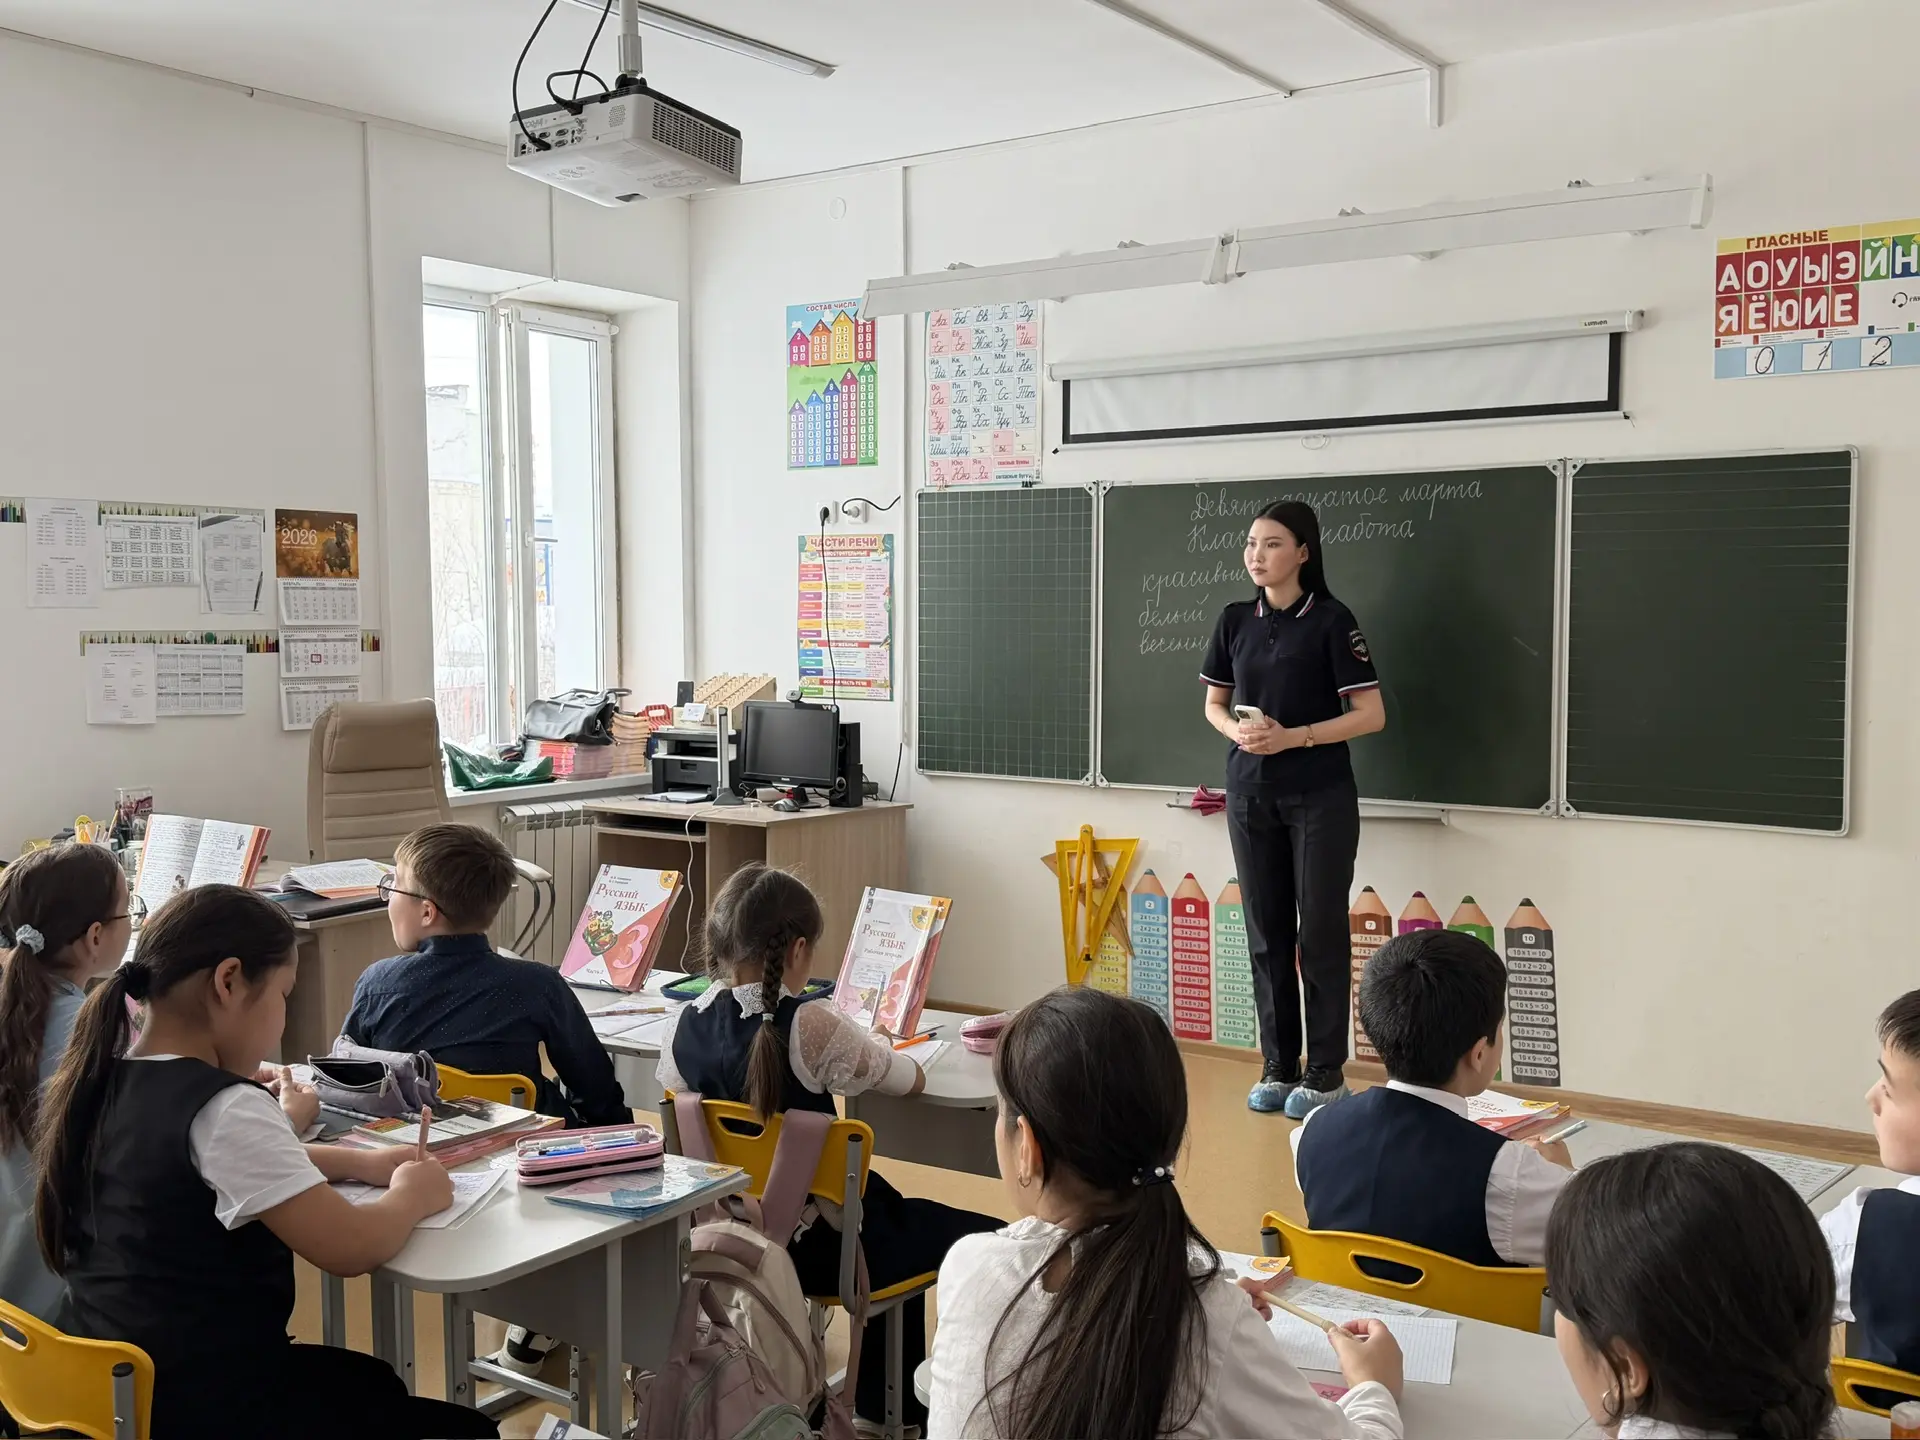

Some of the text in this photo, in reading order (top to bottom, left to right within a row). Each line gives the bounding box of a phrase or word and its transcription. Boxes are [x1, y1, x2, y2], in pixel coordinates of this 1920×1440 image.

[1746, 229, 1829, 250] ГЛАСНЫЕ
[806, 301, 857, 312] СОСТАВ ЧИСЛА
[1755, 336, 1892, 374] 0 1 2
[1190, 480, 1482, 521] Девятцатое марта
[281, 528, 317, 545] 2026
[849, 537, 877, 547] РЕЧИ
[1187, 524, 1247, 553] Клас
[1138, 593, 1209, 627] белый
[596, 883, 639, 899] Русский
[862, 924, 896, 938] Русский
